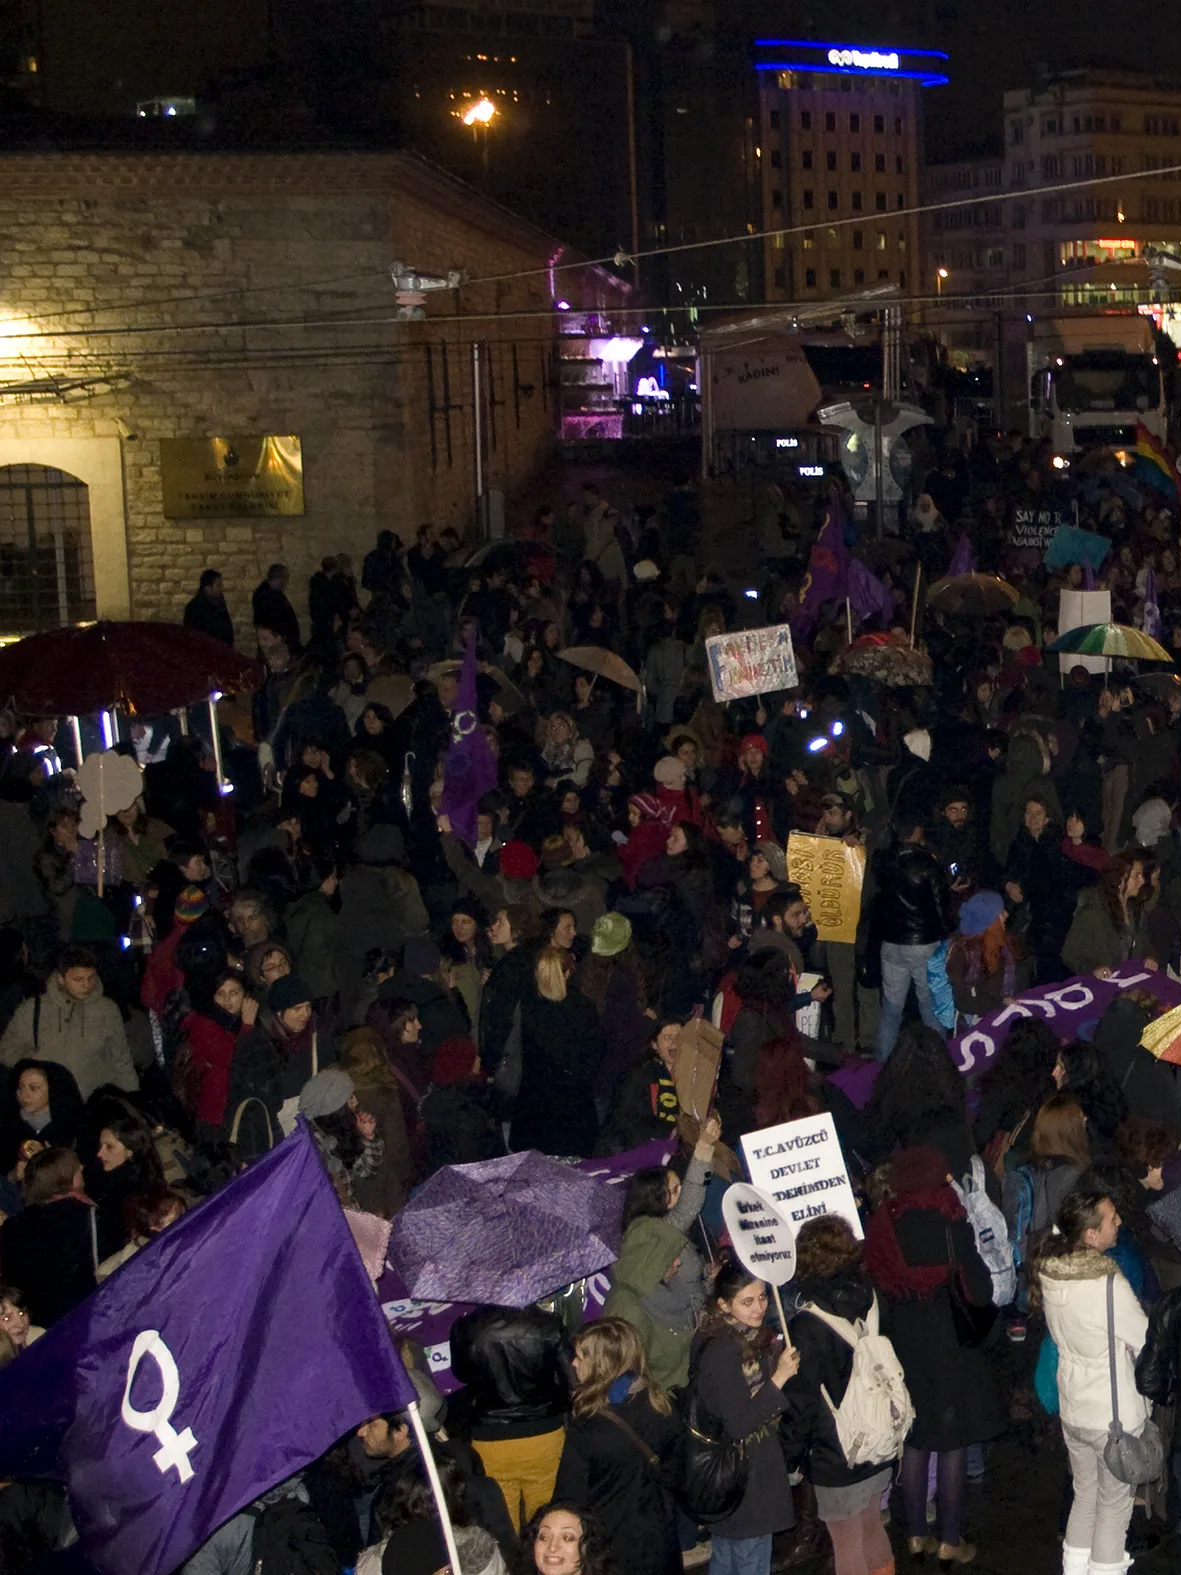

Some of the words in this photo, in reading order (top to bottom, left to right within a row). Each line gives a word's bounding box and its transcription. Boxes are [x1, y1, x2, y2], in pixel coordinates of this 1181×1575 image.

[1016, 510, 1034, 523] SAY
[1038, 511, 1051, 524] NO
[1015, 524, 1058, 537] VIOLENC
[816, 849, 846, 928] ÖLDÜRÜR
[770, 1156, 821, 1180] DEVLET
[791, 1200, 828, 1222] ELİNİ
[750, 1250, 792, 1264] etmiyoruz
